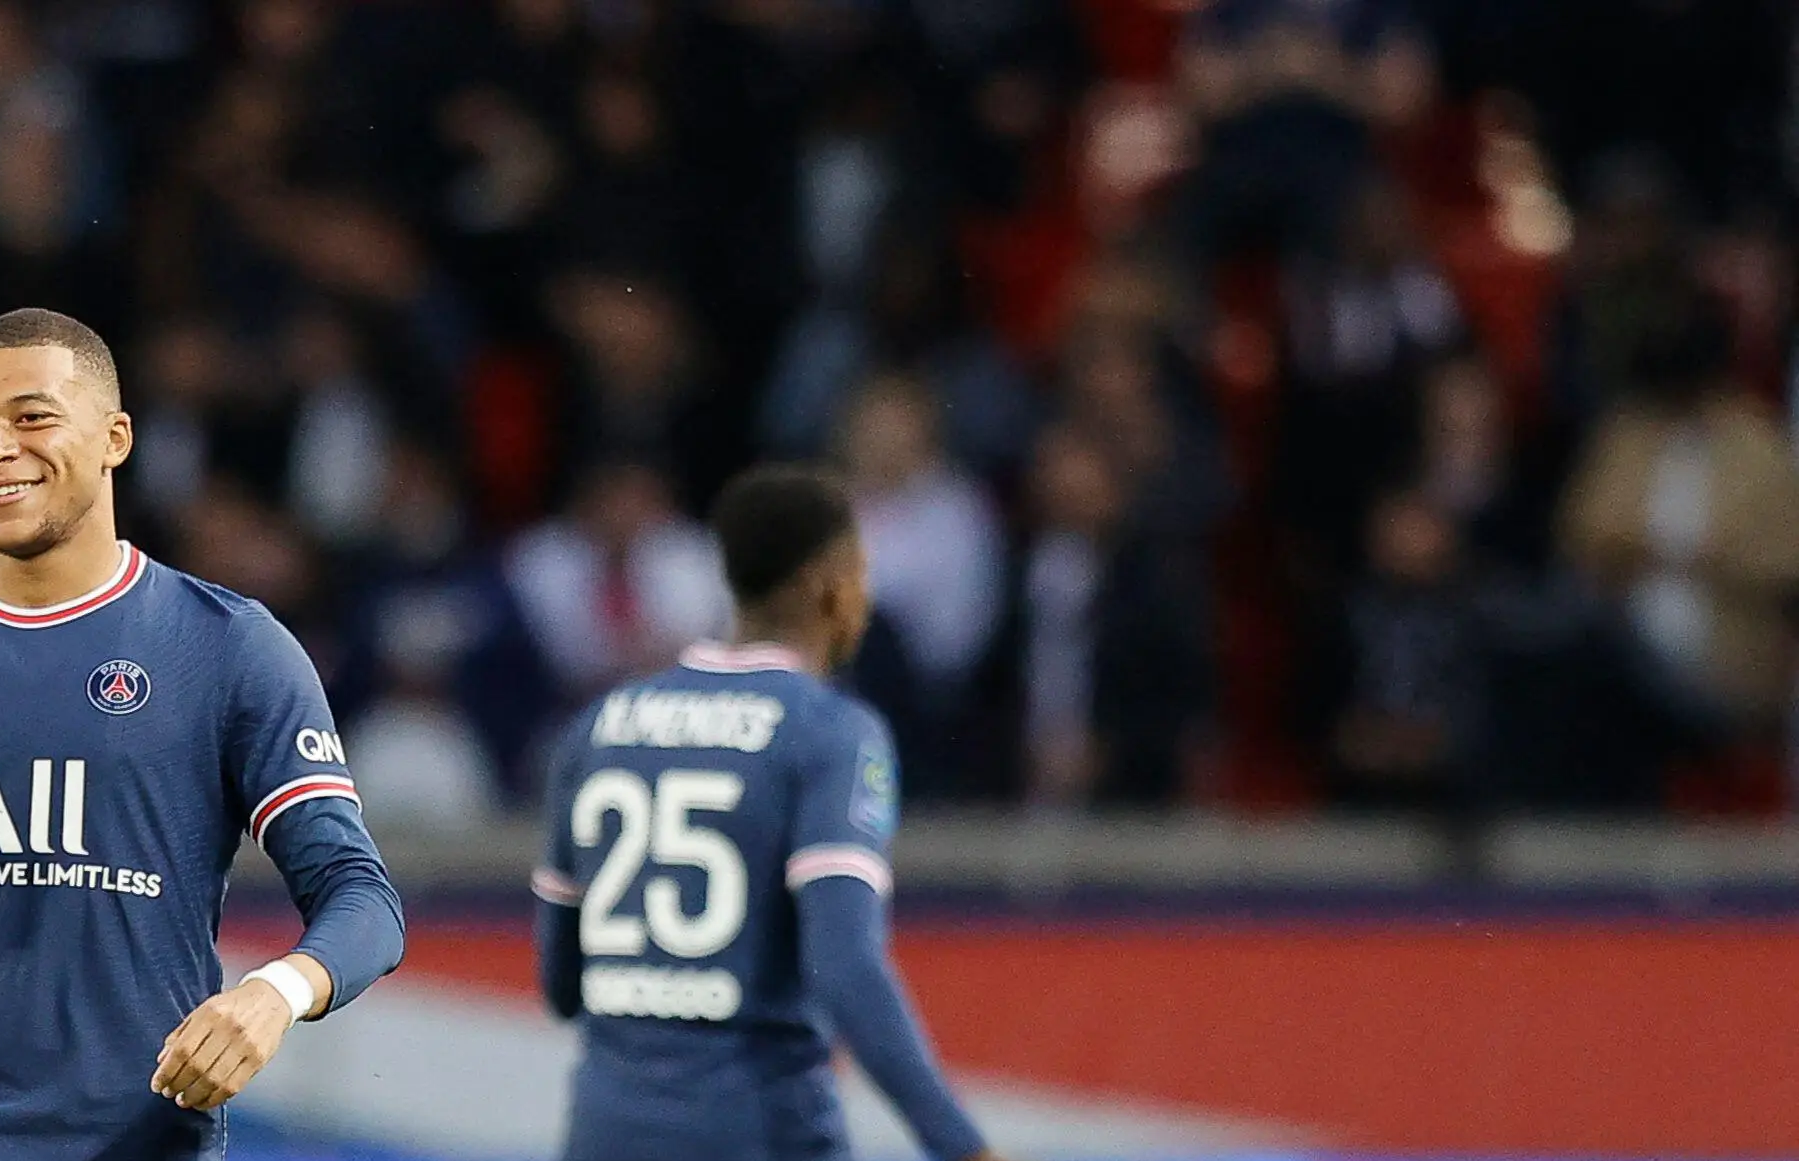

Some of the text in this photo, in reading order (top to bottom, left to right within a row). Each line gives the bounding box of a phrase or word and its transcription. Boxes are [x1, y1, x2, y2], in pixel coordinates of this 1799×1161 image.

[99, 661, 141, 679] PARIS
[33, 862, 162, 898] LIMITLESS
[570, 766, 749, 959] 25
